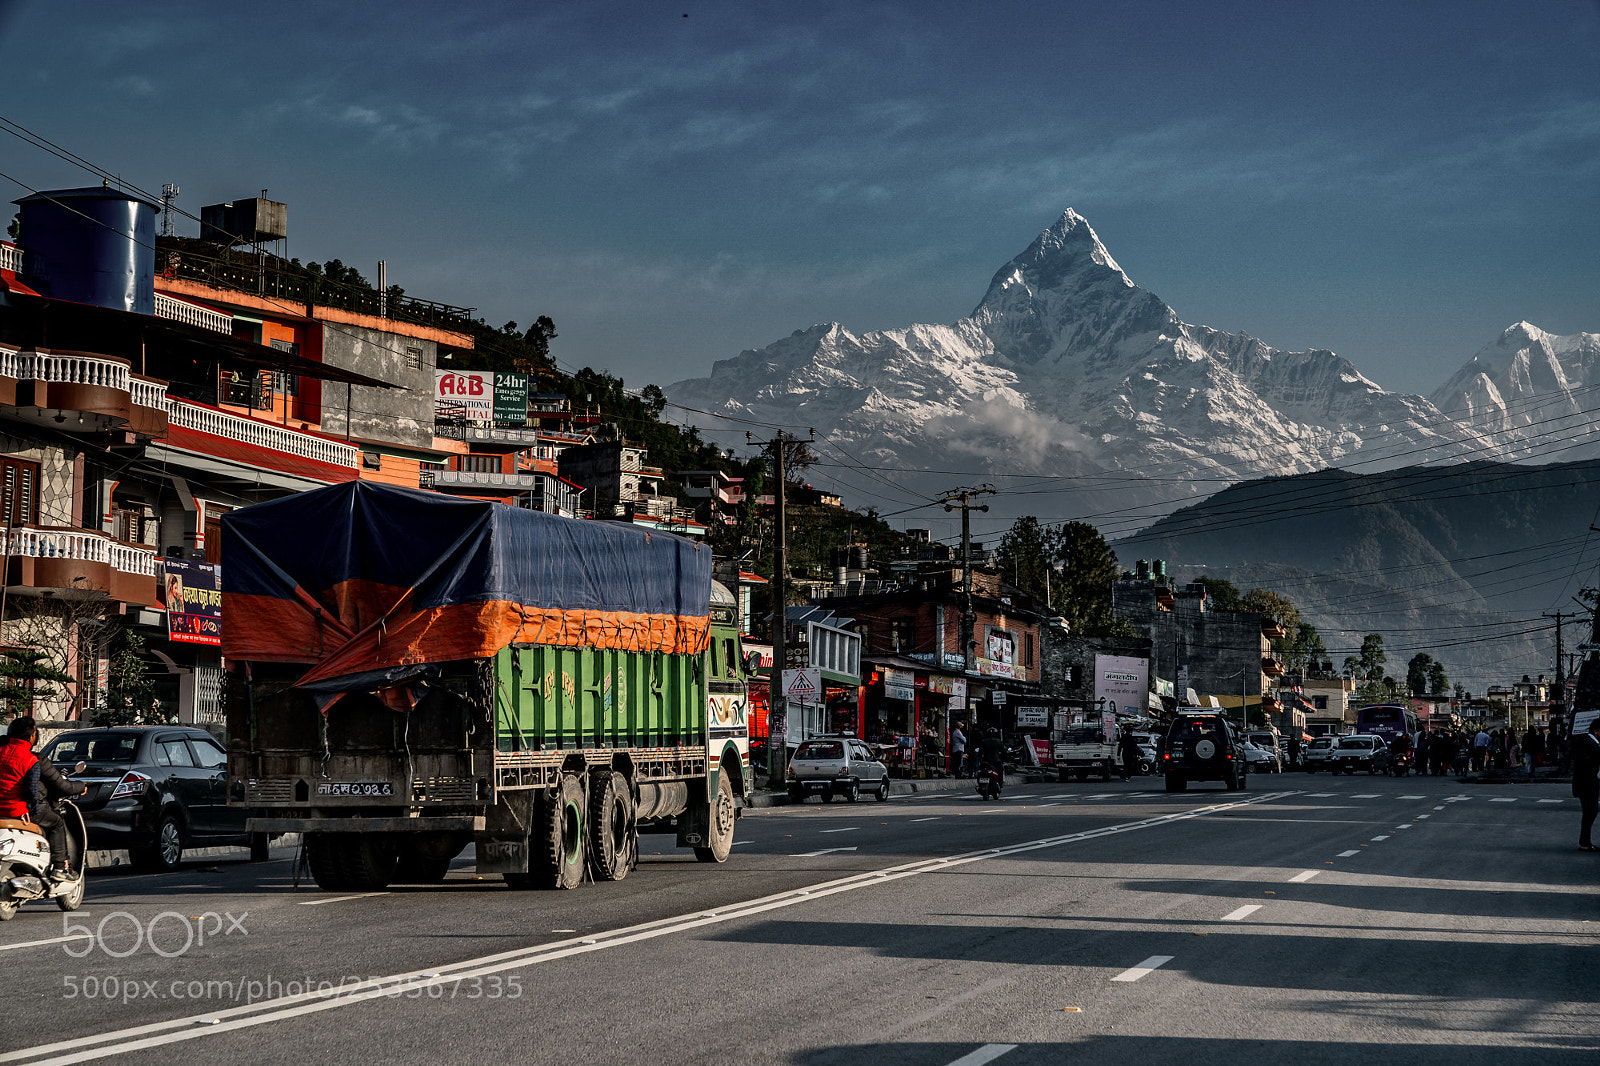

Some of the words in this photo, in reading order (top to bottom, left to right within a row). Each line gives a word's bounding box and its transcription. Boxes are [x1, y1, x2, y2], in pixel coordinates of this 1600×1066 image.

[439, 374, 484, 396] A&B
[496, 374, 526, 388] 24hr
[439, 399, 491, 410] INTERNATIONAL
